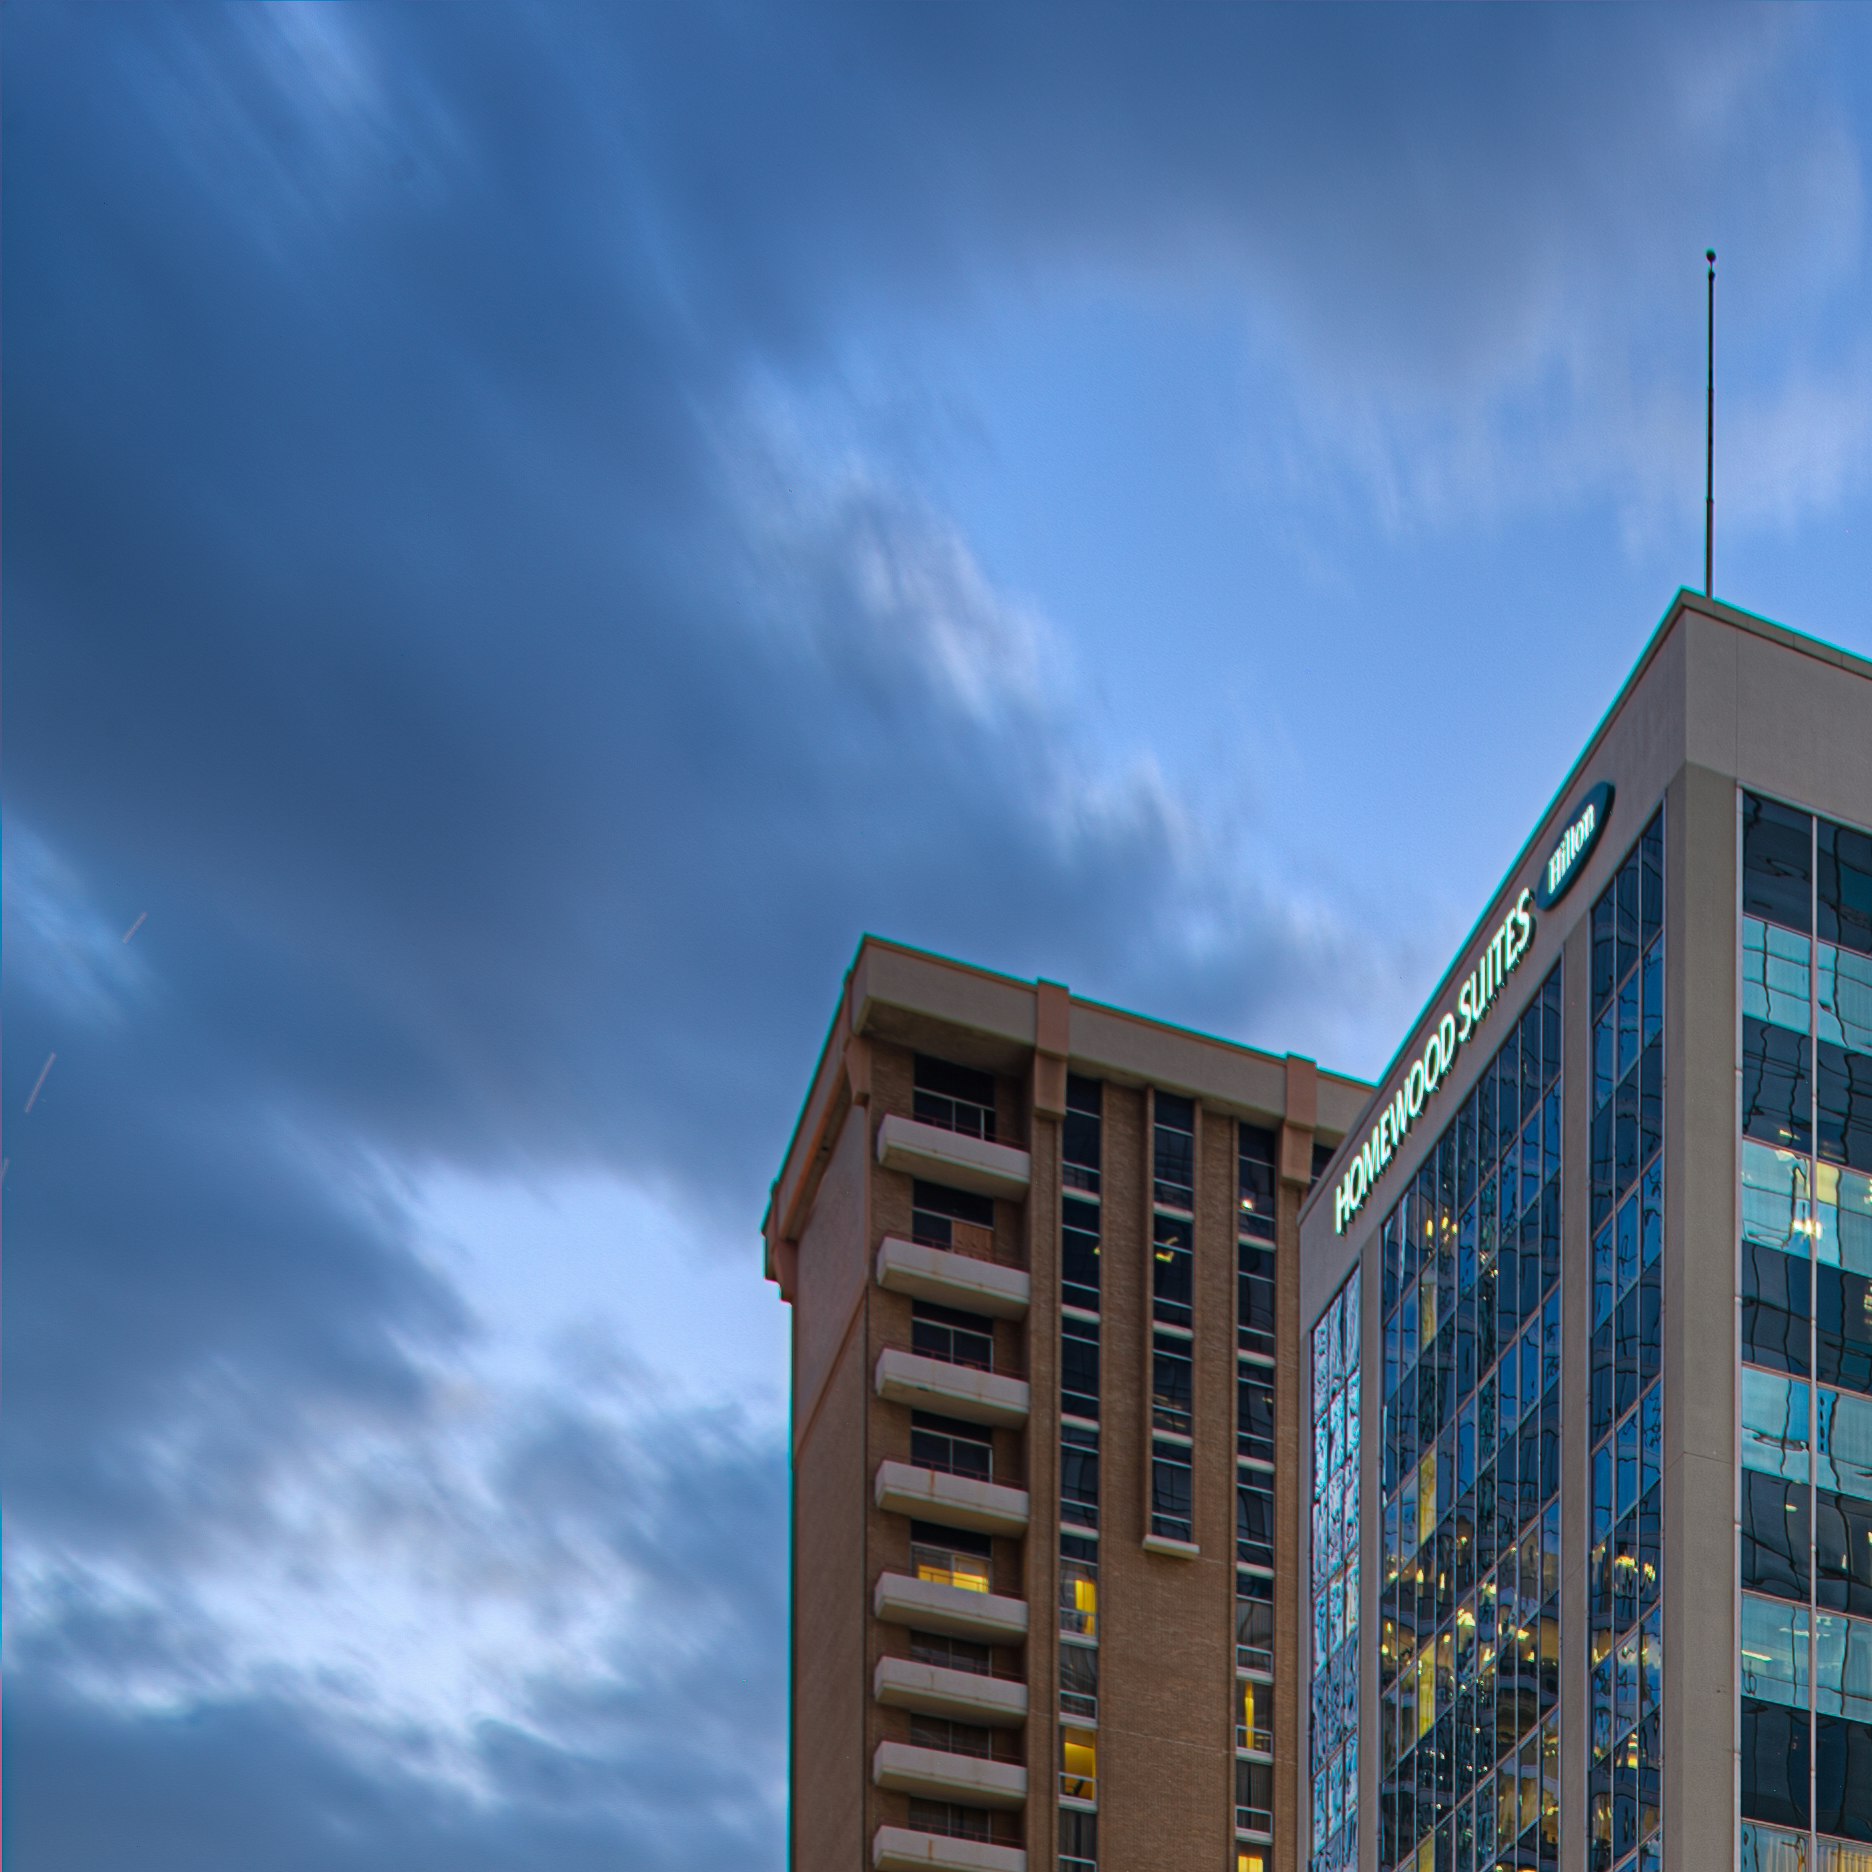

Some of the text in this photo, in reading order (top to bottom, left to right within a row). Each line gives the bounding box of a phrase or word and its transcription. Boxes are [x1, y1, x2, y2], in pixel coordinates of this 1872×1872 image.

[1548, 804, 1594, 894] Hilton
[1336, 888, 1530, 1234] HOMEWOOD SUITES
